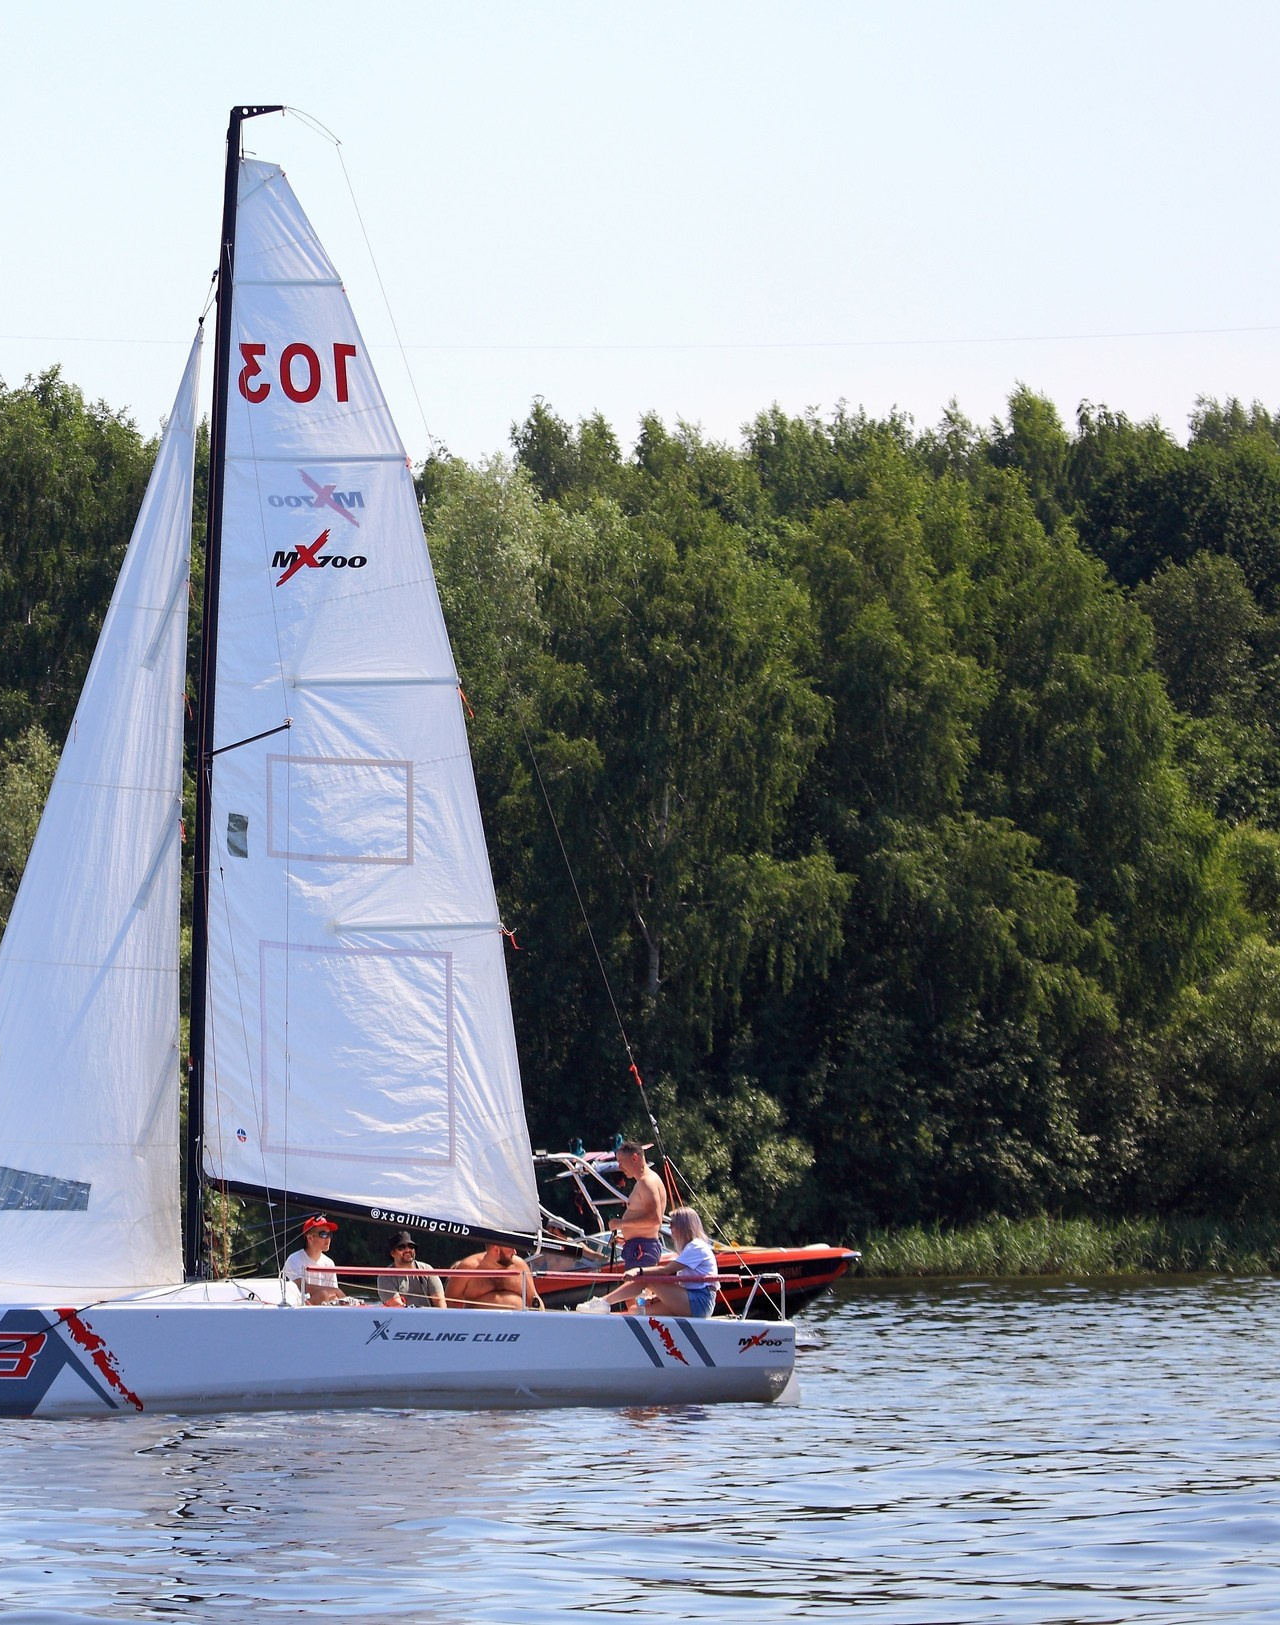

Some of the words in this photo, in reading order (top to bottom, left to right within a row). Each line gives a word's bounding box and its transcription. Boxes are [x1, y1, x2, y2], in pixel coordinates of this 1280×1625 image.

[271, 528, 368, 588] MX700
[370, 1207, 470, 1236] @xsailingclub
[392, 1331, 470, 1342] SAILING
[472, 1332, 520, 1342] CLUB
